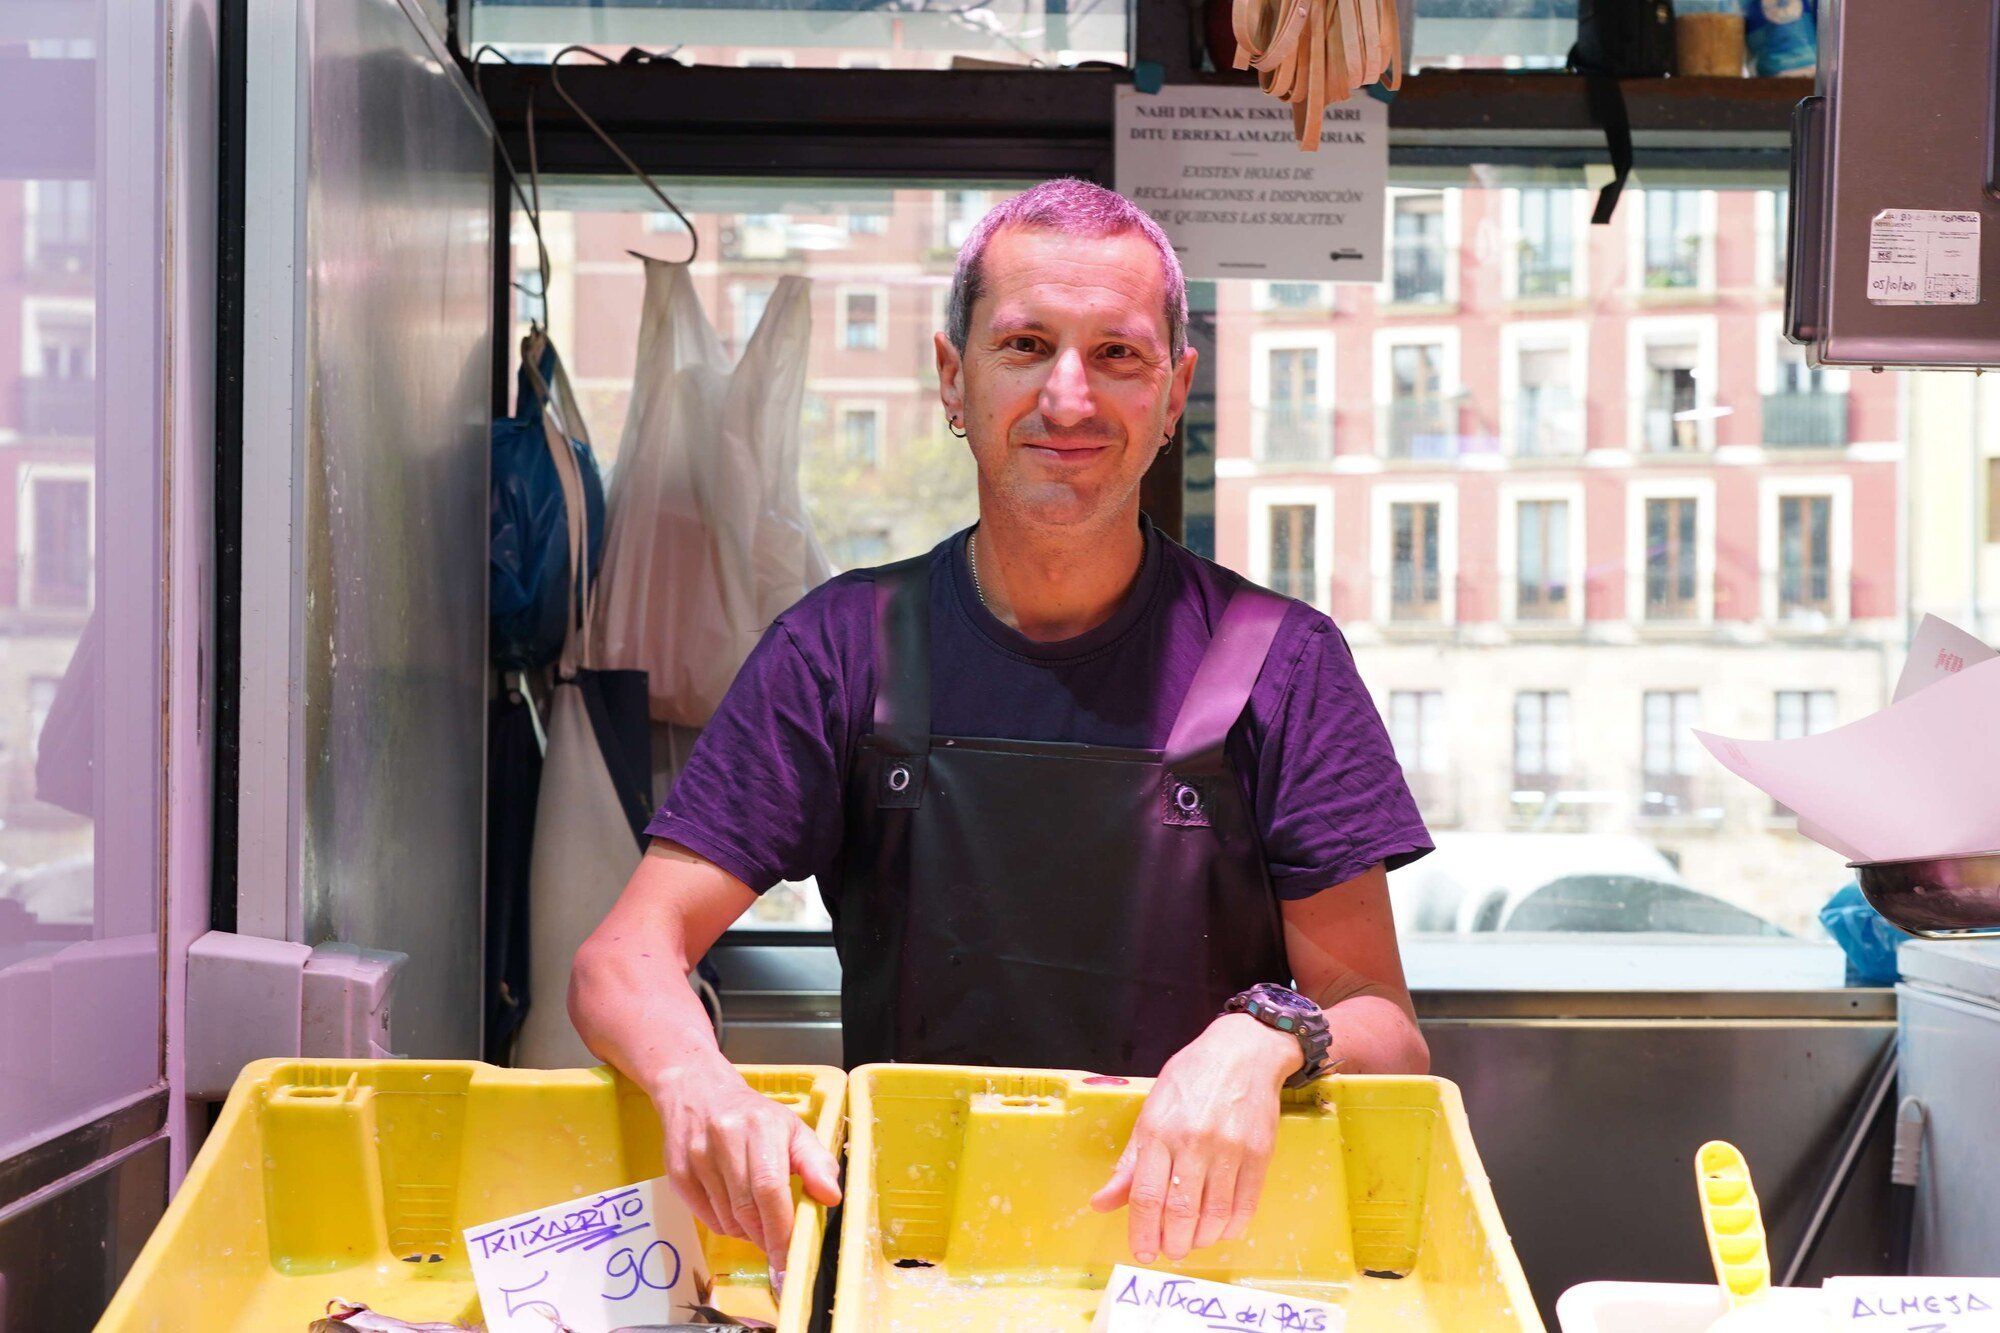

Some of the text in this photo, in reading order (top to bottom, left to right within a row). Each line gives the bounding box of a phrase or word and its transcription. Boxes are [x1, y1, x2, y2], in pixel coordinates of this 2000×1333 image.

[1136, 105, 1361, 121] NAHI DUENAK ESKUARRI
[1130, 127, 1166, 141] DITU
[1181, 165, 1315, 180] EXISTEN HOJAS DE
[1133, 187, 1254, 202] RECLAMACIONES
[1259, 190, 1267, 201] A
[1151, 209, 1346, 226] DE QUIENES LAS SOLICITEN
[601, 1240, 681, 1301] 90
[1852, 1293, 1993, 1318] ALMEJA
[1235, 1305, 1266, 1327] del
